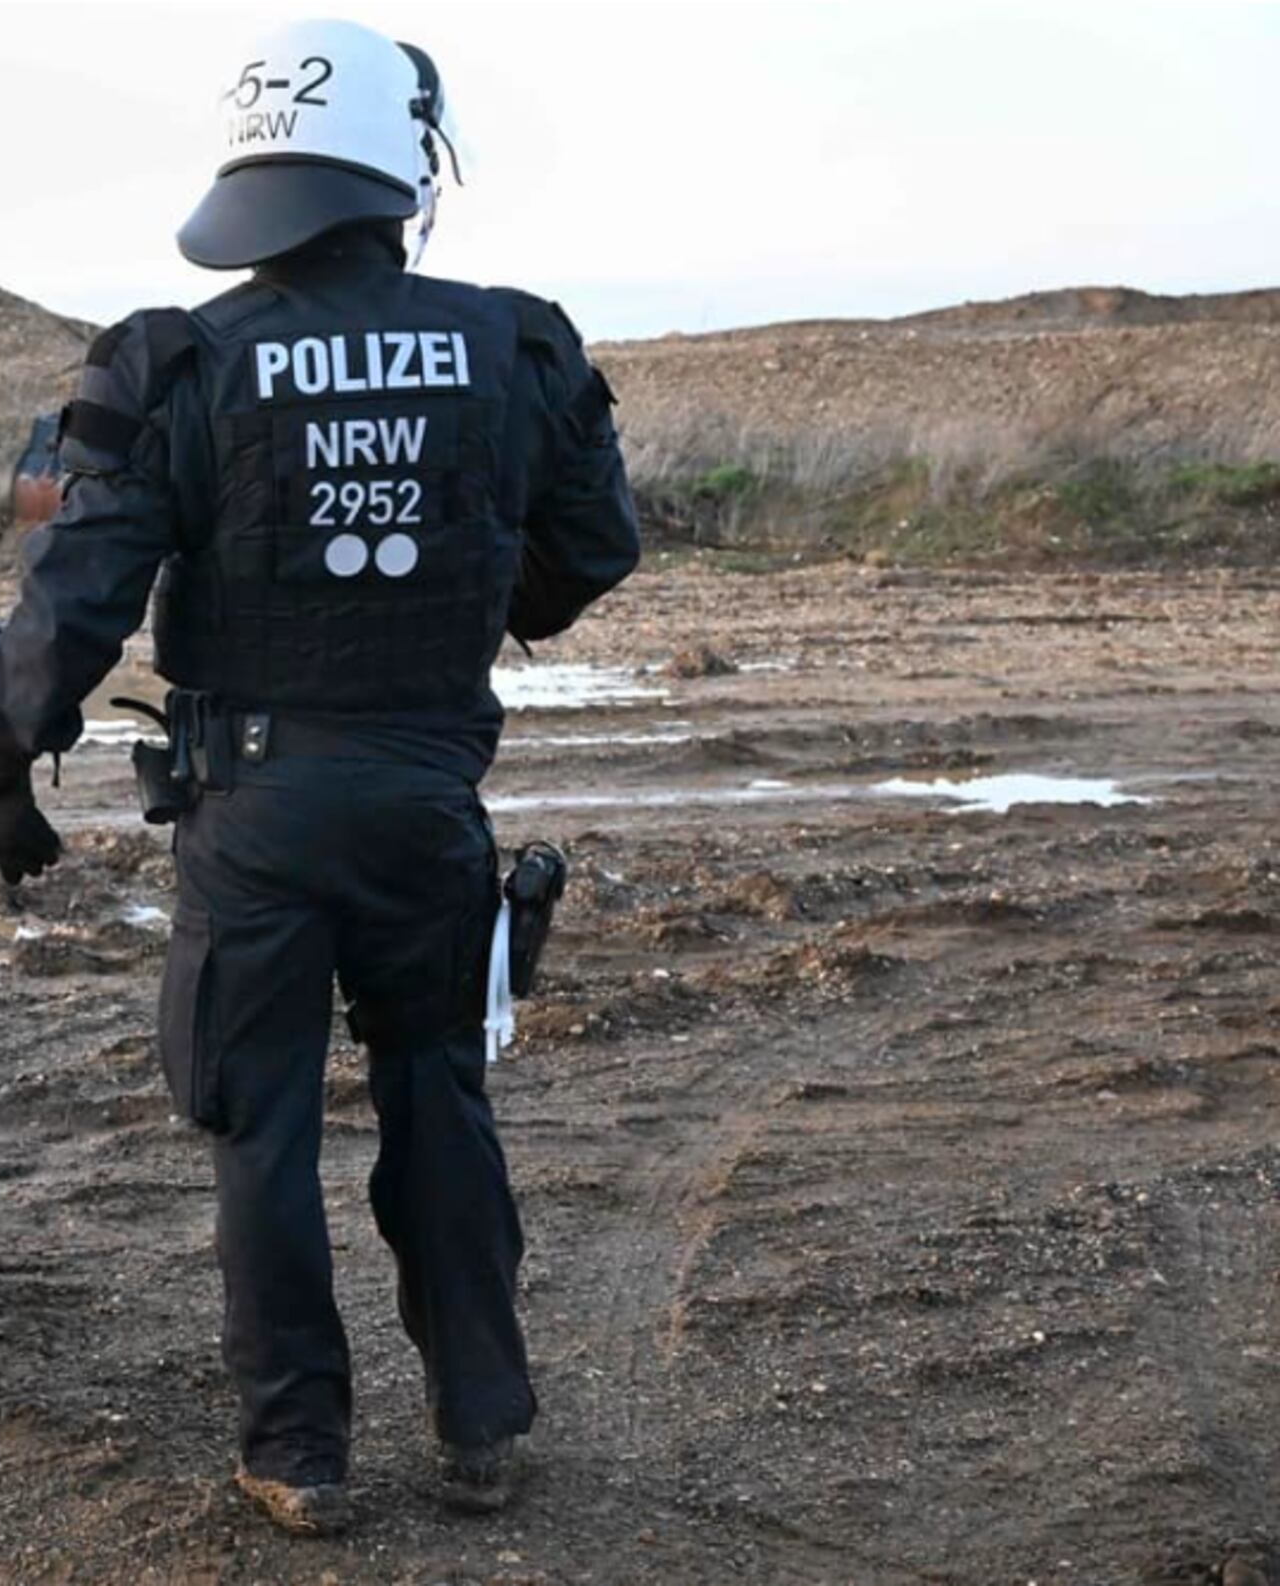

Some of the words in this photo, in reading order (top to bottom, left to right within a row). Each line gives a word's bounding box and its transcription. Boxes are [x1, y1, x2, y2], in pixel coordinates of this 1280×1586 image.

[256, 331, 470, 398] POLIZEI
[306, 416, 427, 469] NRW
[310, 479, 422, 526] 2952
